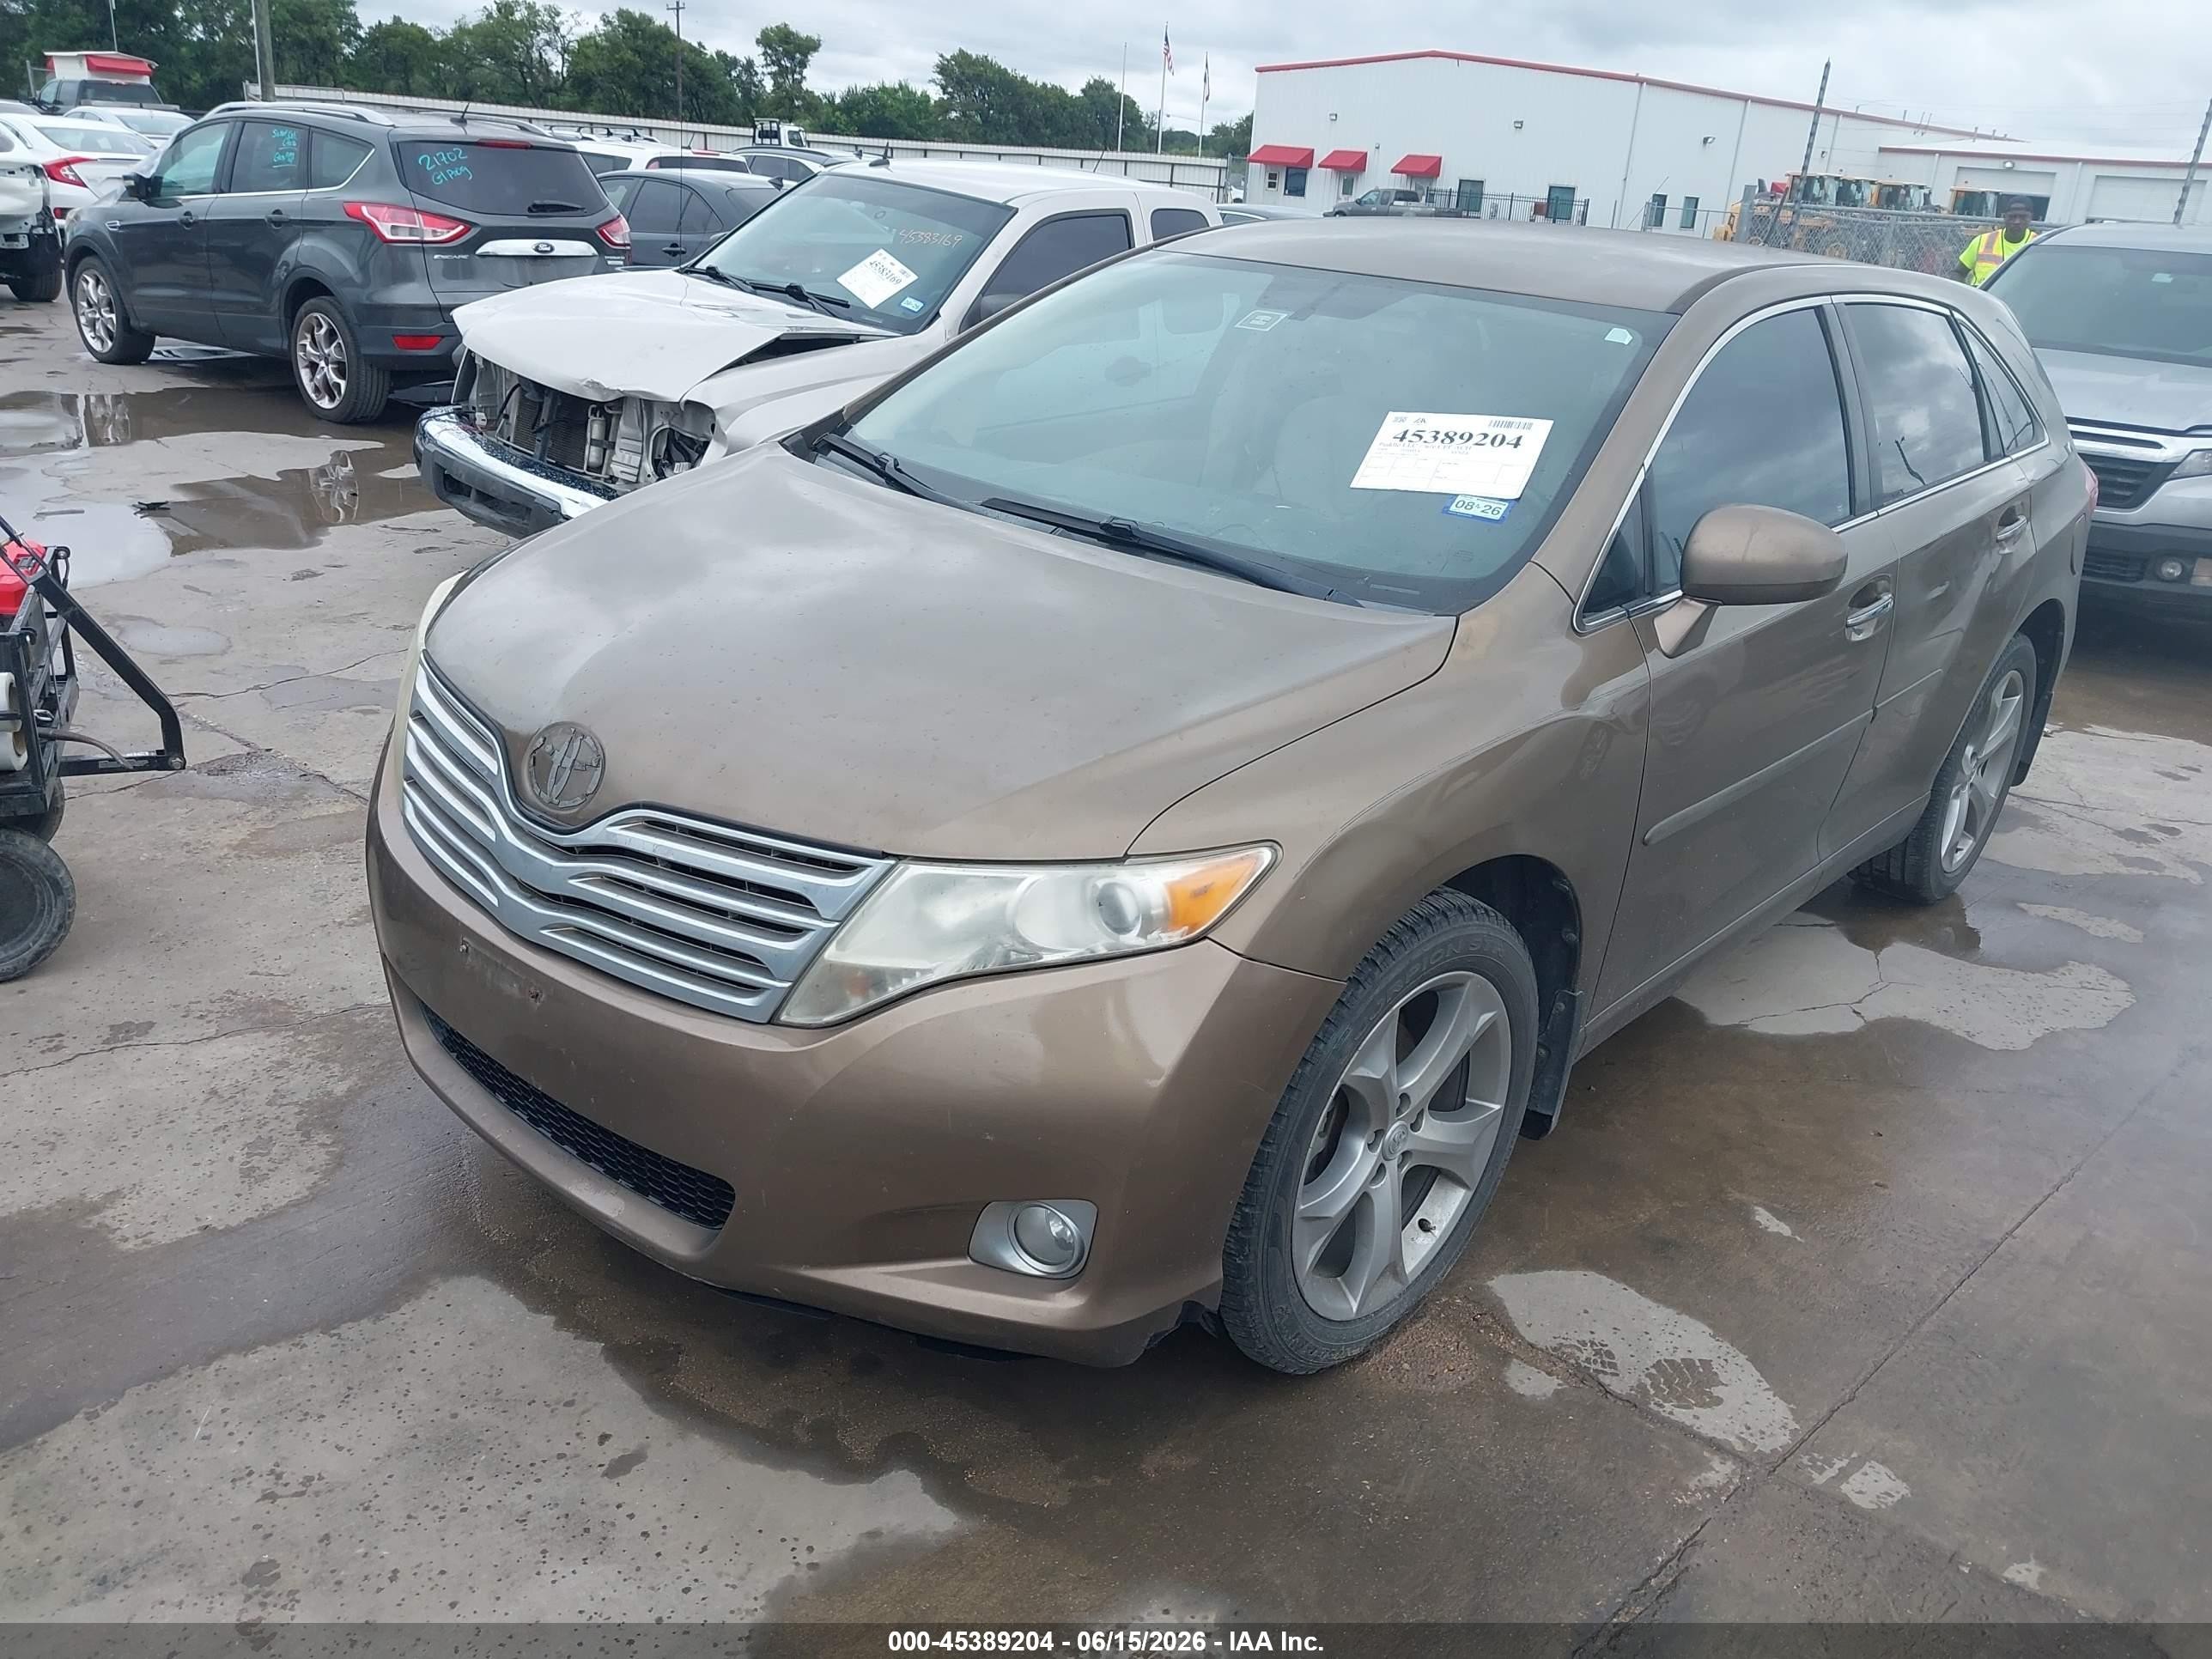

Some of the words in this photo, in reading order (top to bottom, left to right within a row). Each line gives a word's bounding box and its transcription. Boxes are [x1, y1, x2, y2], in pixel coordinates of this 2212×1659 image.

[418, 147, 468, 171] 21702
[899, 228, 963, 248] 45383169
[1392, 428, 1523, 449] 45389204
[1455, 500, 1475, 511] 08
[1480, 504, 1502, 516] 26
